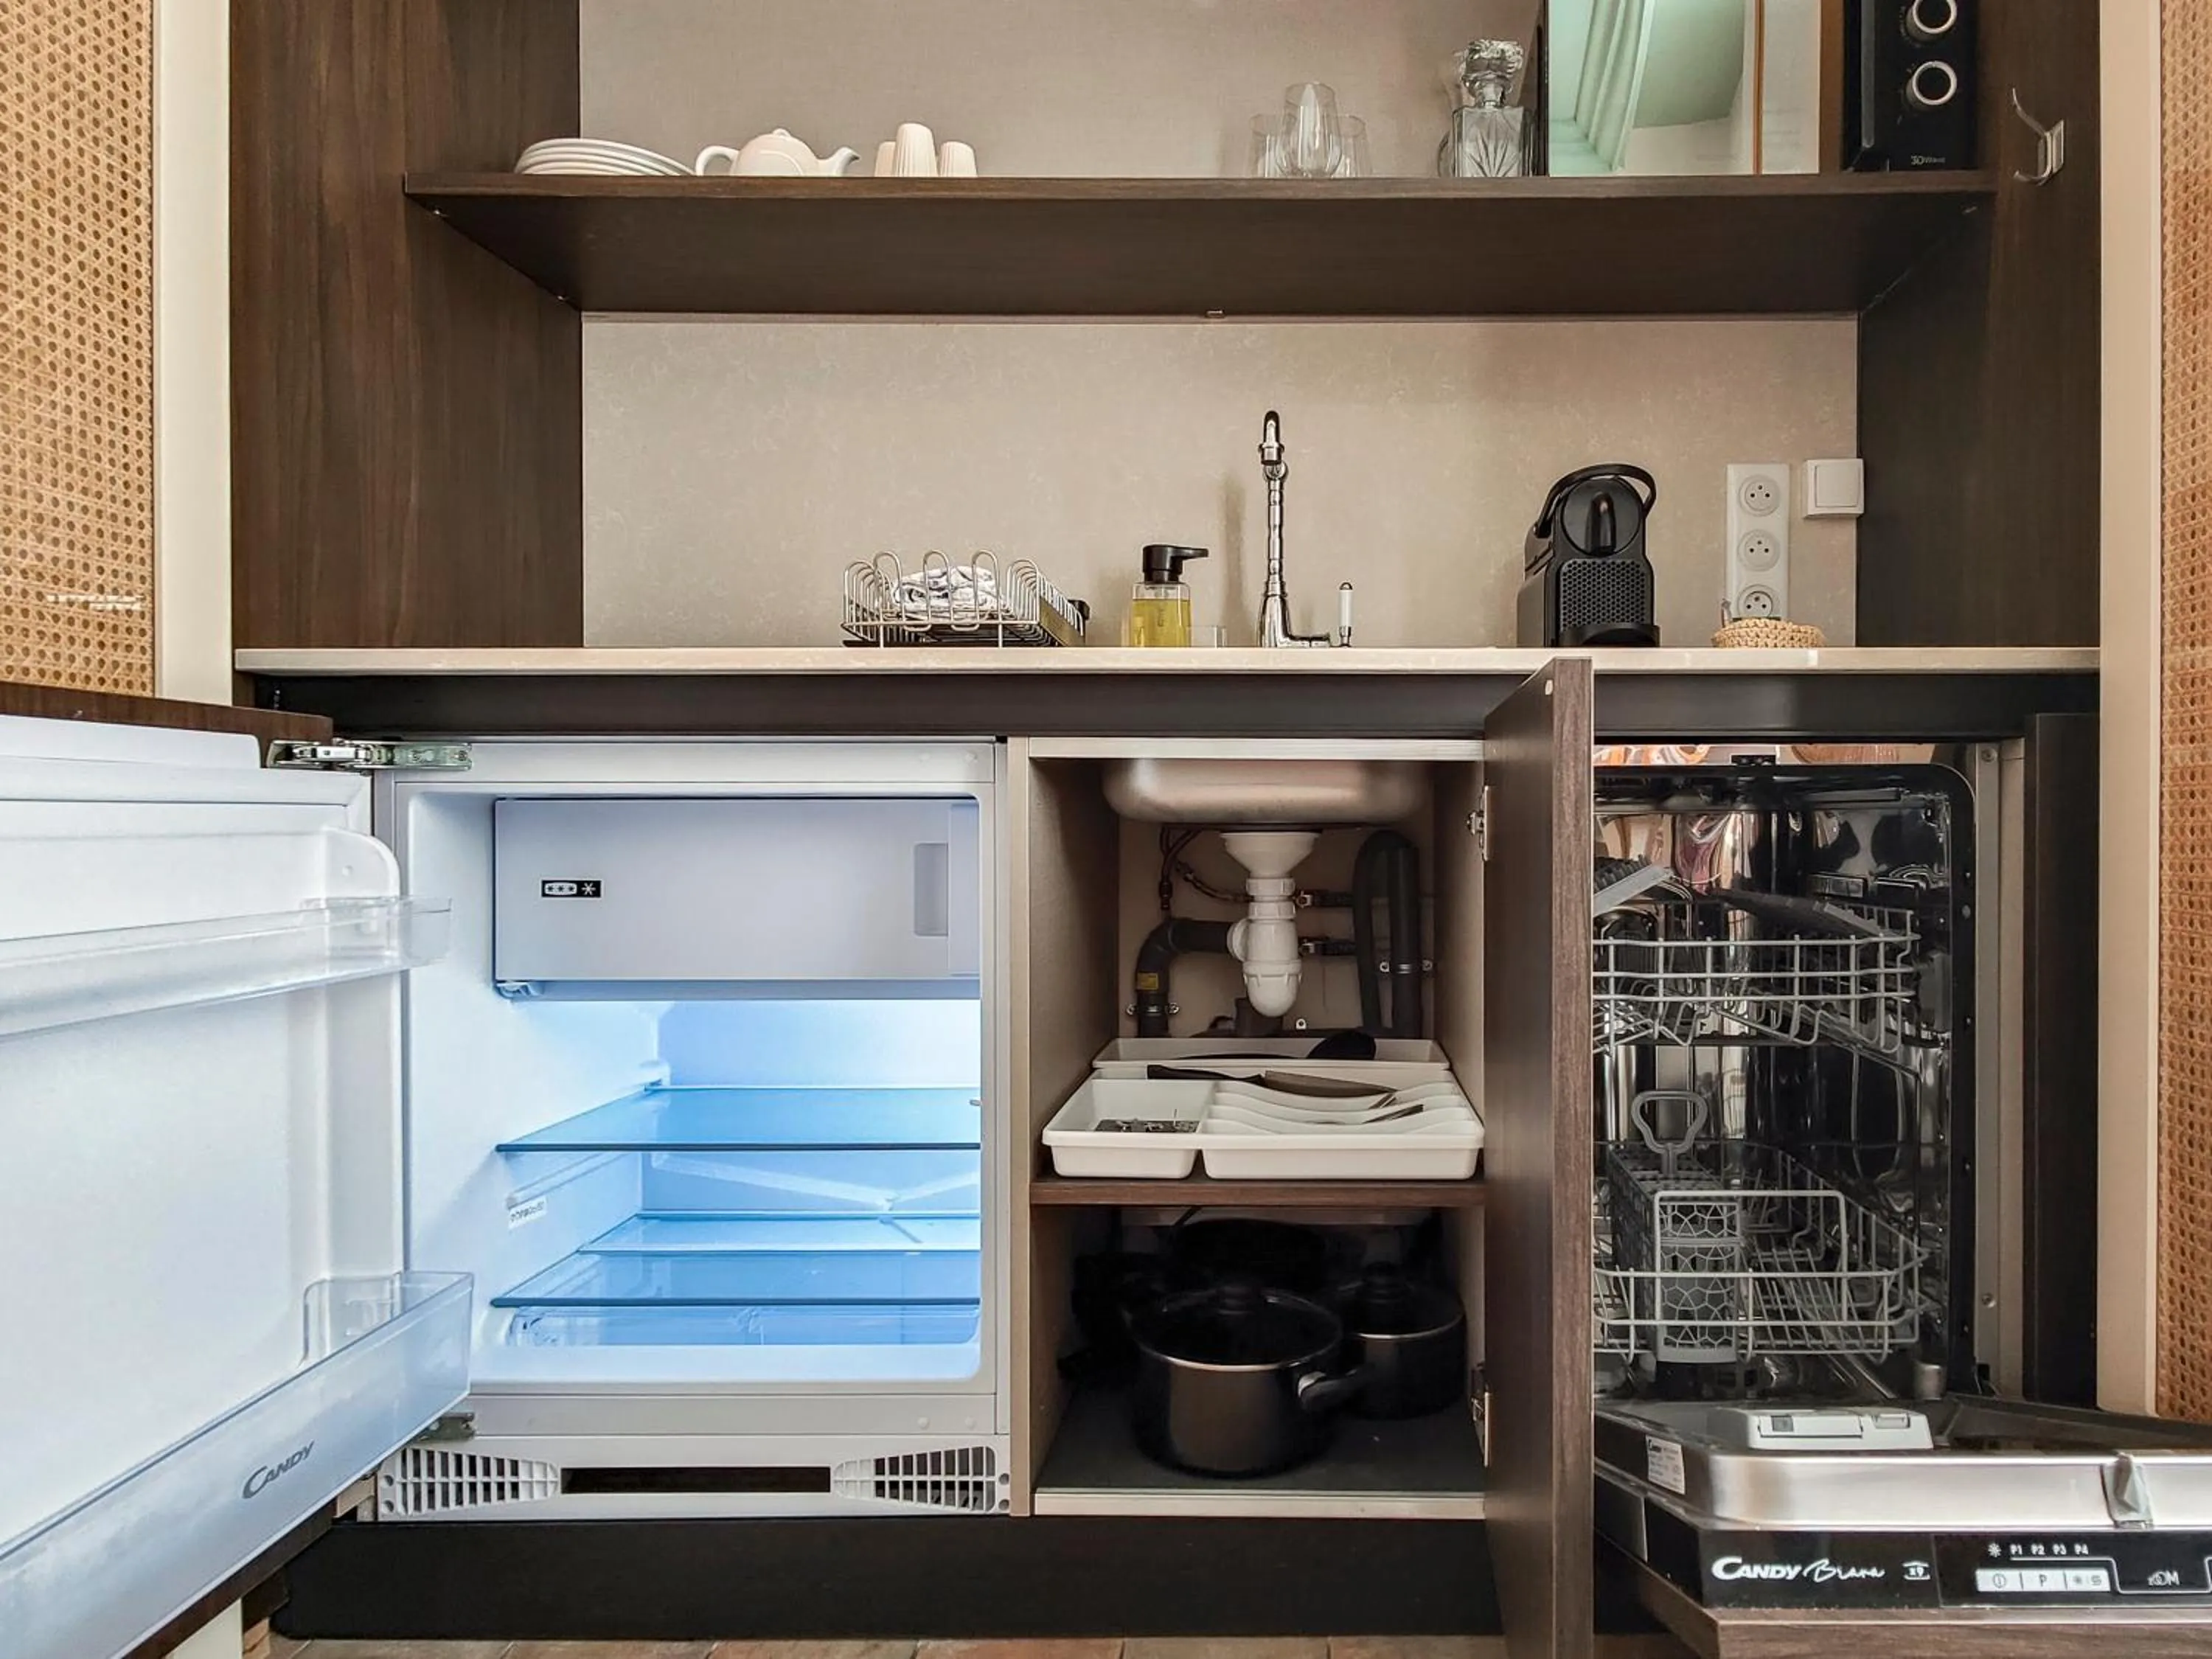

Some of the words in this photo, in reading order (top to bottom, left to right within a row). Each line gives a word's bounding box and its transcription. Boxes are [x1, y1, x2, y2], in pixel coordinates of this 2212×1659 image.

[242, 1440, 315, 1500] CANDY
[2009, 1544, 2023, 1555] P1
[2031, 1545, 2045, 1555] P2
[2052, 1545, 2067, 1555] P3
[2073, 1544, 2089, 1555] P4
[1711, 1556, 1802, 1581] CANDY
